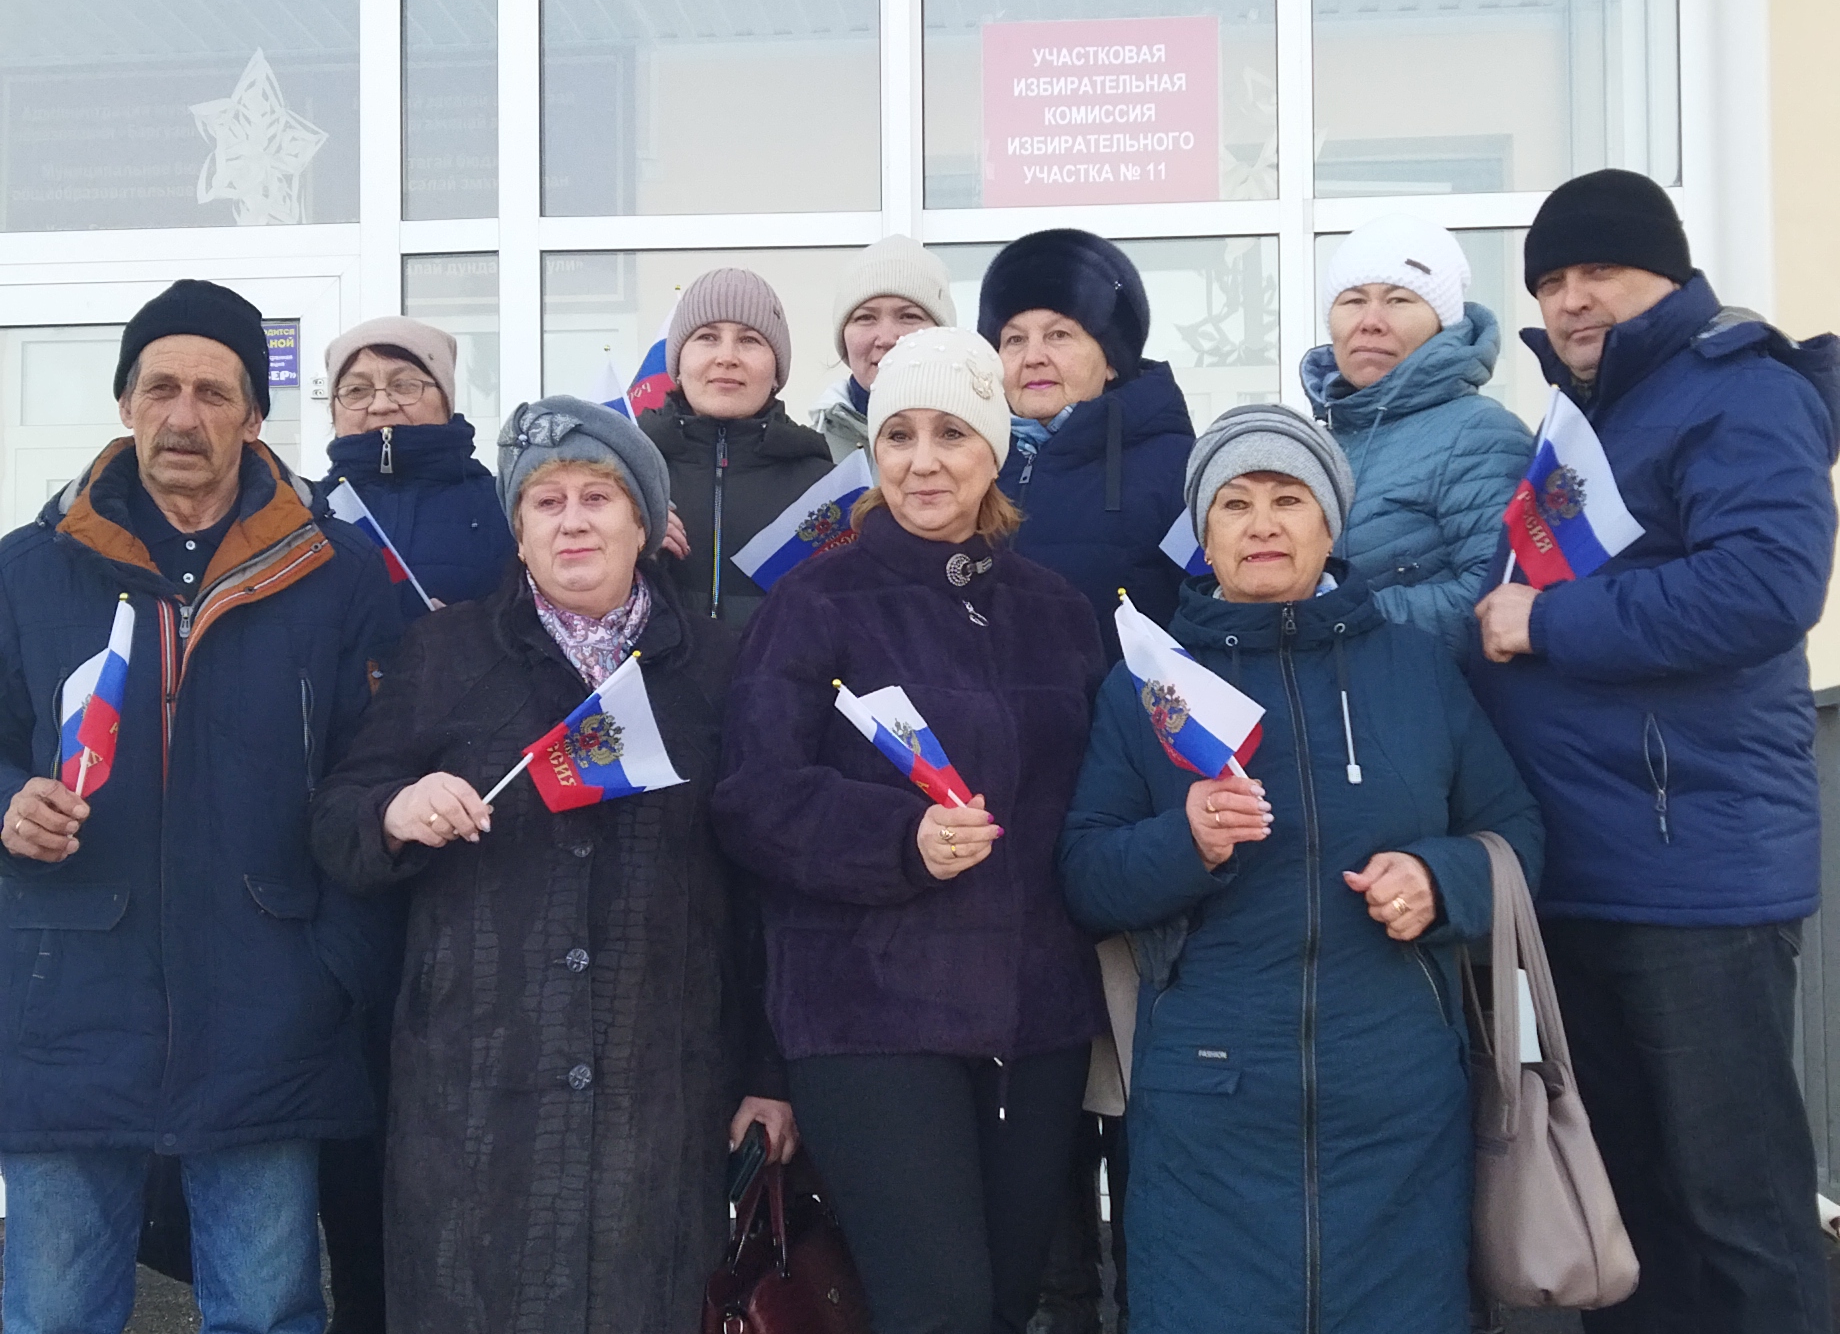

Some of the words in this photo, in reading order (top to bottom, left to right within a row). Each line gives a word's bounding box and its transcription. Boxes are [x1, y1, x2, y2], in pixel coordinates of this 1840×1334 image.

[1032, 44, 1166, 67] УЧАСТКОВАЯ
[1013, 73, 1187, 97] ИЗБИРАТЕЛЬНАЯ
[1044, 103, 1156, 125] КОМИССИЯ
[1007, 131, 1195, 156] ИЗБИРАТЕЛЬНОГО
[1023, 163, 1114, 185] УЧАСТКА
[1120, 162, 1141, 181] №
[1146, 161, 1166, 181] 11
[267, 336, 294, 348] НОЙ
